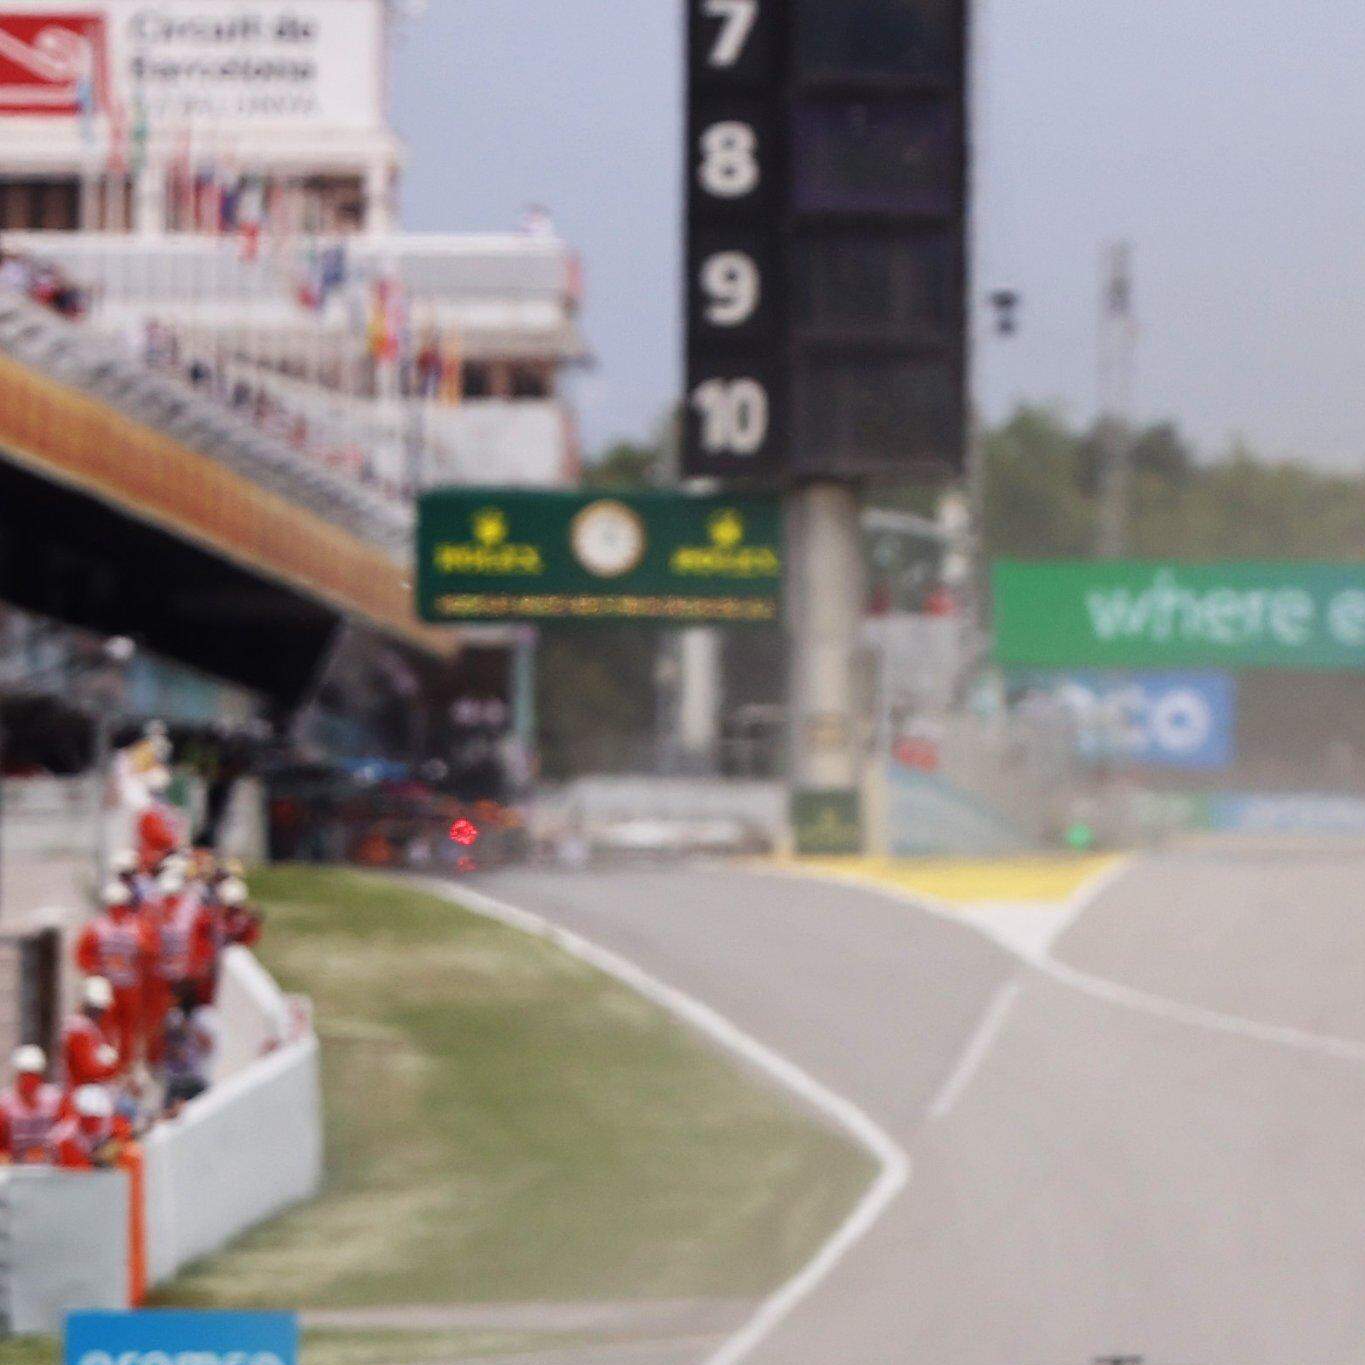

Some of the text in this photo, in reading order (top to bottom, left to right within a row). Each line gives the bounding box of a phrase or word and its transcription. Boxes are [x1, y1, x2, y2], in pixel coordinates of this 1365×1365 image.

[706, 0, 760, 67] 7
[699, 121, 760, 198] 8
[700, 250, 760, 326] 9
[692, 377, 768, 456] 10
[1087, 569, 1314, 645] where
